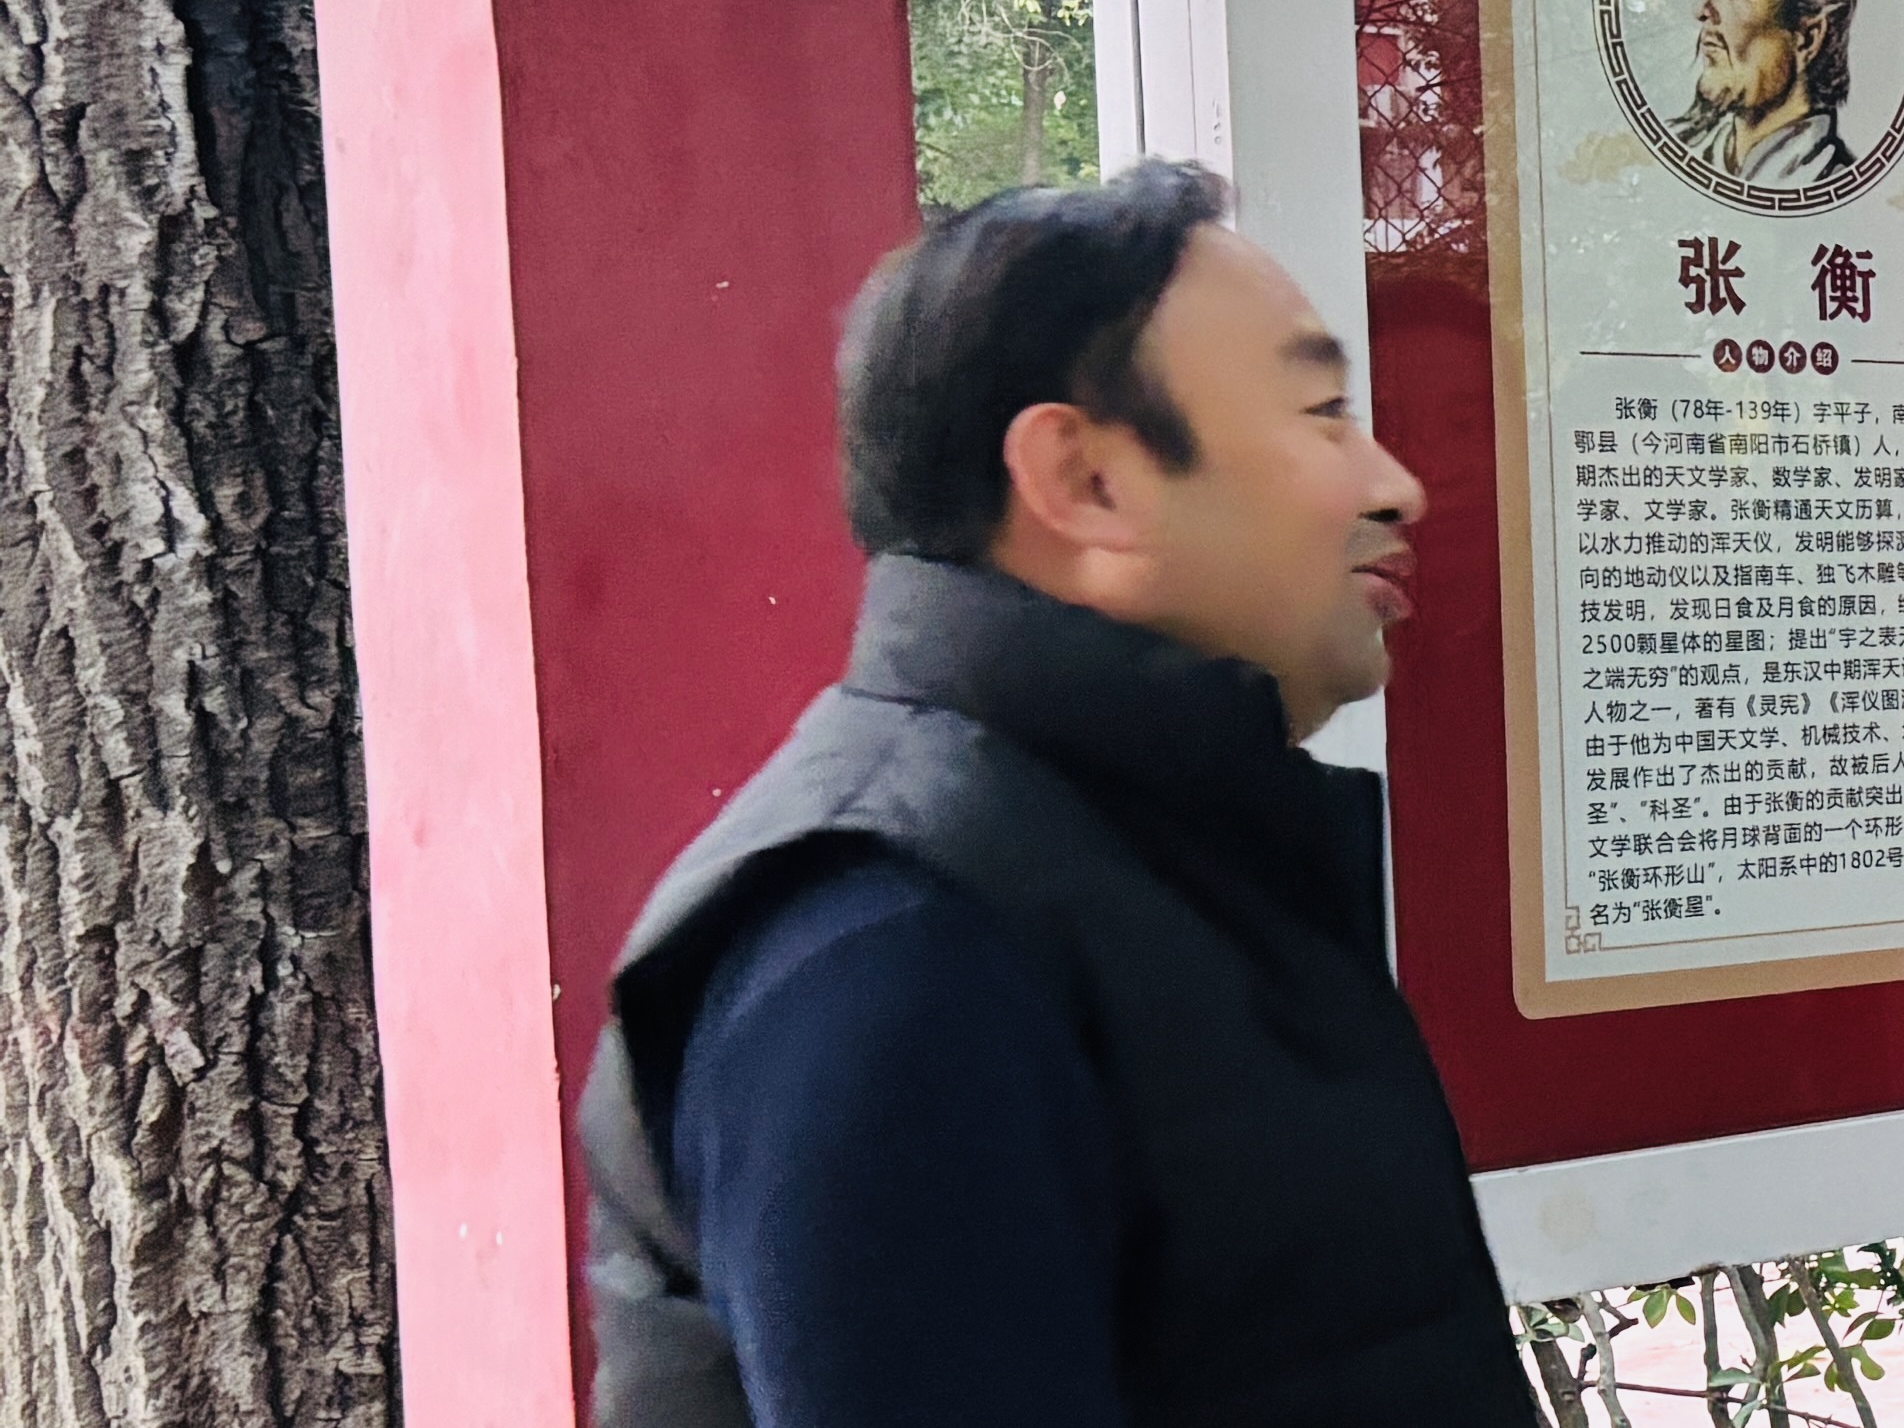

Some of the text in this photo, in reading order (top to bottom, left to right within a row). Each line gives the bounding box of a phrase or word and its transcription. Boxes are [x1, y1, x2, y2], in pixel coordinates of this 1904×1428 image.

[1716, 343, 1835, 372] 人物介绍
[1590, 895, 1721, 926] 名为“张衡星”。
